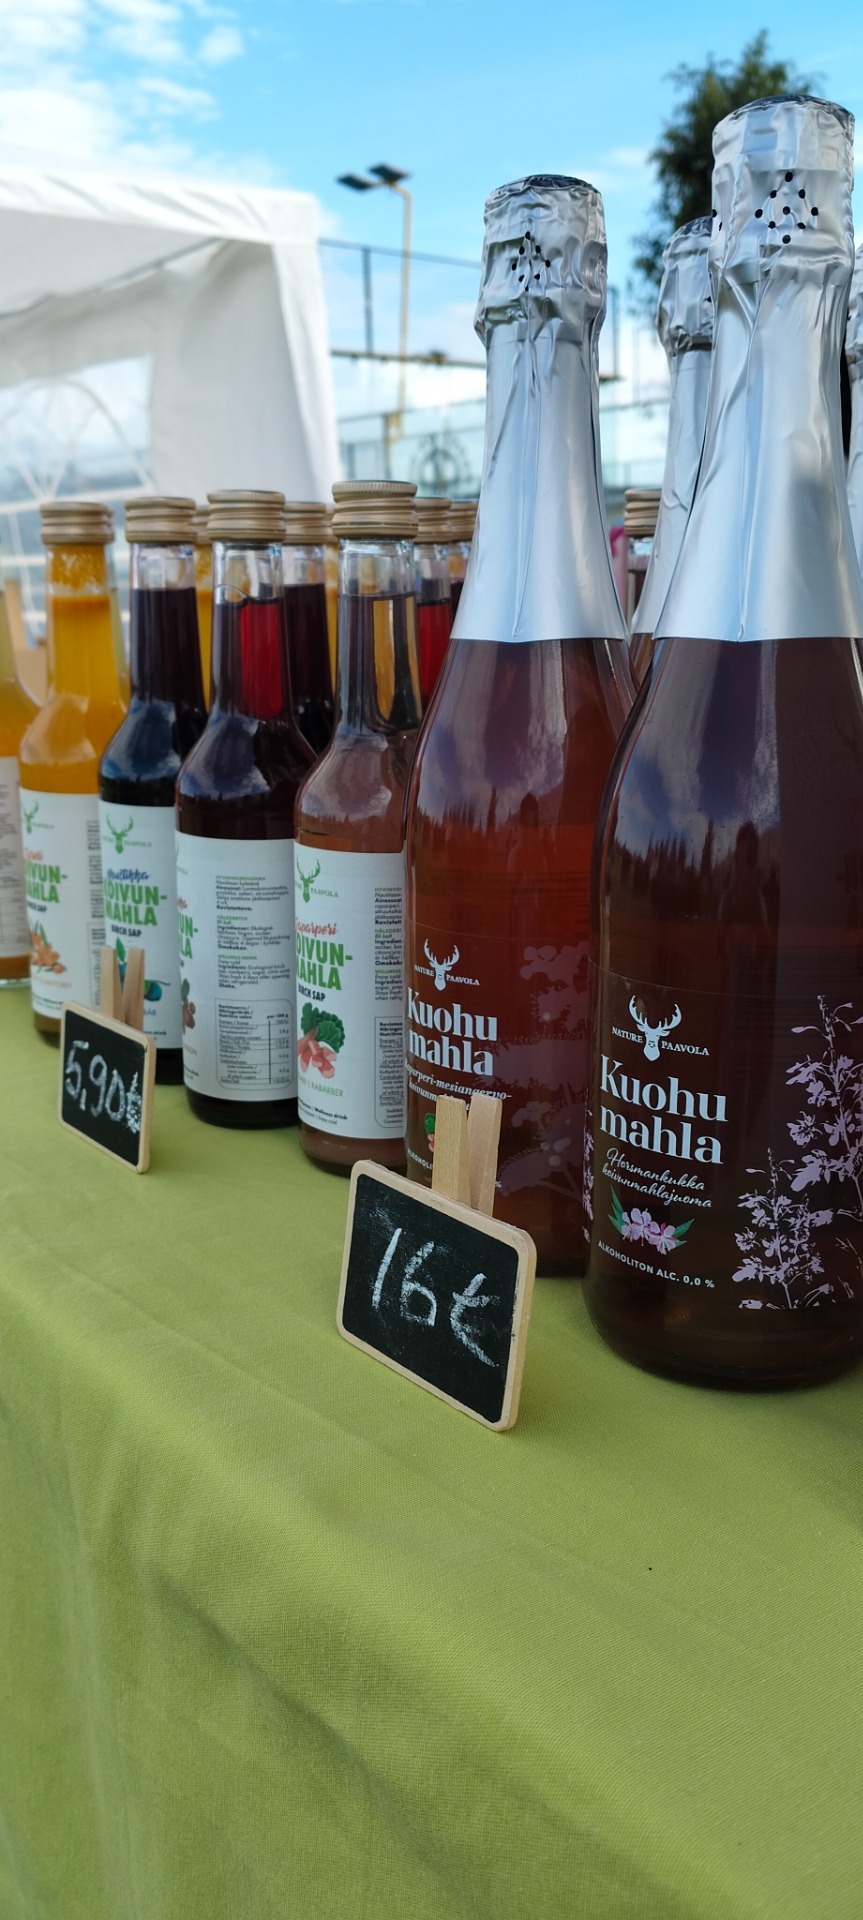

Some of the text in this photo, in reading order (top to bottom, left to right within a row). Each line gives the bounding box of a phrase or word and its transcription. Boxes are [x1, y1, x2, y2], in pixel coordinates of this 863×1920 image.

[310, 887, 339, 898] PAAVOLA
[128, 927, 142, 938] SAP
[312, 990, 325, 1002] SAP
[414, 964, 480, 986] NATURE PAAVOLA
[407, 986, 498, 1042] Kuohu
[408, 1029, 493, 1076] mahla
[612, 1026, 710, 1056] NATURE PAAVOLA
[311, 1082, 344, 1097] RABARBER
[600, 1053, 729, 1122] Kuohu
[600, 1104, 723, 1165] mahla
[602, 1162, 713, 1208] koivunmahlajuoma
[606, 1147, 706, 1191] Horsmankukka
[597, 1240, 715, 1289] ALKOHOLITON ALC. 0,0 %
[372, 1227, 501, 1368] 16€
